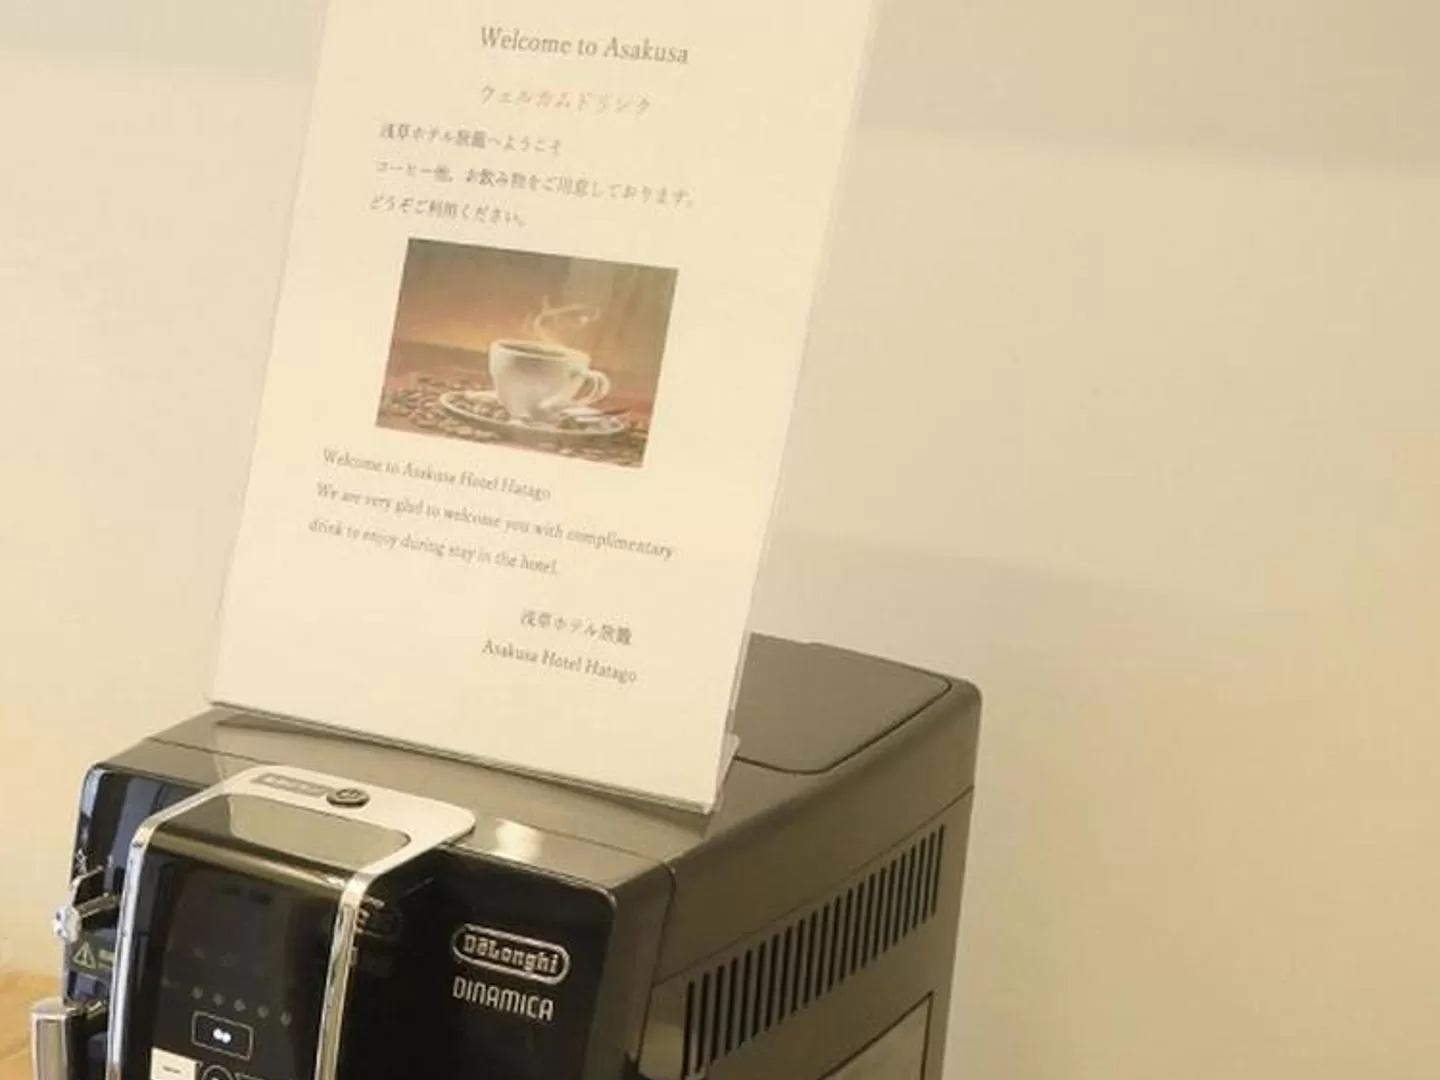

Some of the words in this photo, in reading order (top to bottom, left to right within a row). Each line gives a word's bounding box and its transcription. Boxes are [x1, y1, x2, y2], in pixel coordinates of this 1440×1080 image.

[480, 25, 572, 55] Welcome
[578, 38, 598, 57] to
[603, 36, 689, 64] Asakusa
[323, 449, 383, 473] Welcome
[385, 461, 401, 476] to
[402, 462, 456, 486] Asakusa
[460, 471, 499, 491] Hotel
[500, 477, 552, 501] Hatago
[309, 518, 343, 538] drink
[347, 525, 361, 539] to
[363, 530, 399, 552] enjoy
[400, 532, 444, 558] during
[448, 543, 477, 562] stay
[495, 550, 517, 568] the
[316, 482, 339, 499] We
[341, 491, 362, 504] are
[365, 494, 392, 513] very
[394, 495, 424, 518] glad
[426, 503, 441, 518] to
[443, 505, 501, 528] welcome
[504, 520, 529, 537] you
[534, 520, 563, 540] with
[567, 527, 674, 561] complimentary
[481, 638, 538, 662] Asakusa
[541, 649, 582, 672] Hotel
[585, 659, 637, 684] Hatago
[452, 975, 555, 1021] DINAMICA
